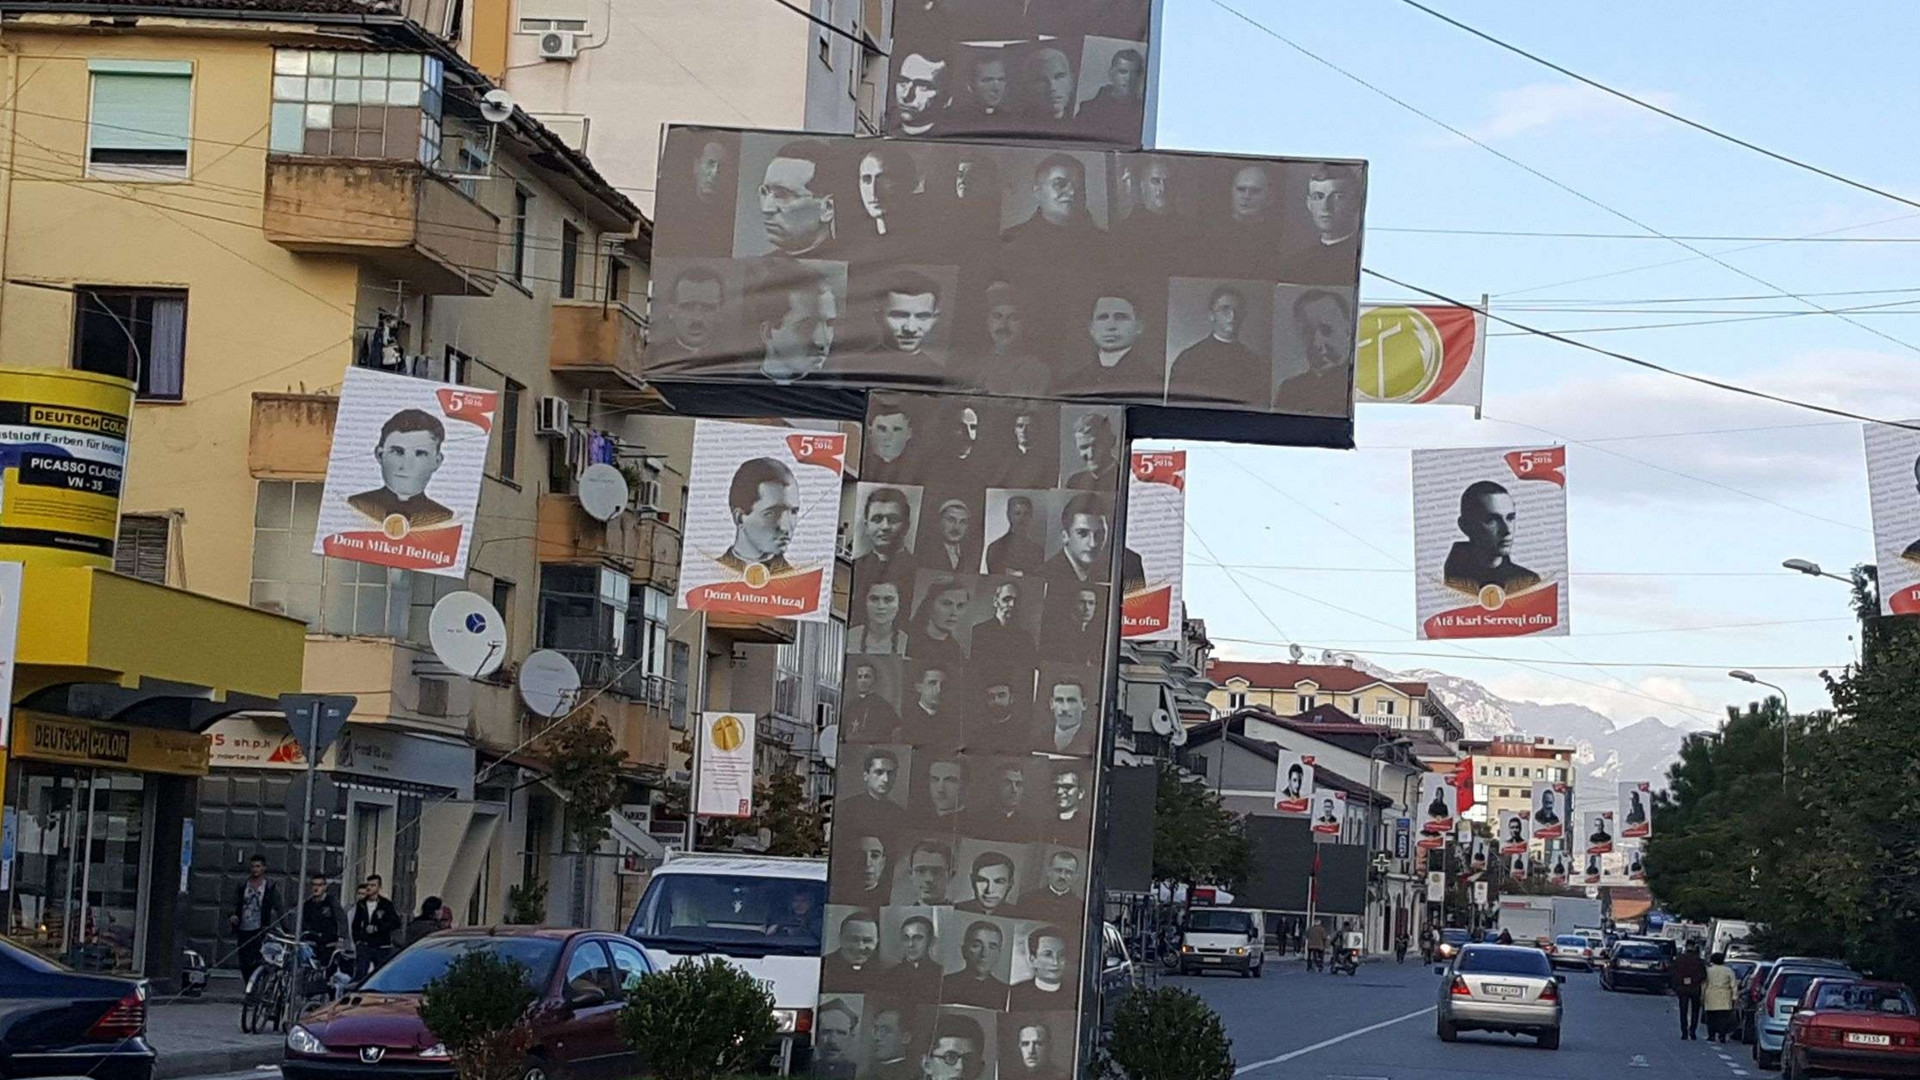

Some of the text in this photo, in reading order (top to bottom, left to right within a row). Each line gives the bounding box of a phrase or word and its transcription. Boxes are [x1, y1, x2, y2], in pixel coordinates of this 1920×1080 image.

[448, 391, 465, 411] 5
[35, 410, 98, 428] DEUTSCH
[0, 430, 40, 441] ststoff
[44, 432, 83, 447] Farben
[86, 438, 102, 450] für
[799, 436, 814, 456] 5
[31, 458, 86, 474] PICASSO
[1140, 455, 1154, 474] 5
[1519, 452, 1533, 472] 5
[68, 476, 84, 488] VN
[91, 480, 103, 491] 35
[333, 534, 451, 564] Dom Mikel Beltoja
[704, 588, 805, 609] Dom Anton Muzaj
[1138, 616, 1160, 626] ofm
[1456, 615, 1481, 626] Karl
[1528, 613, 1552, 624] ofm
[35, 724, 88, 752] DEUTSCH
[90, 730, 128, 758] COLOR
